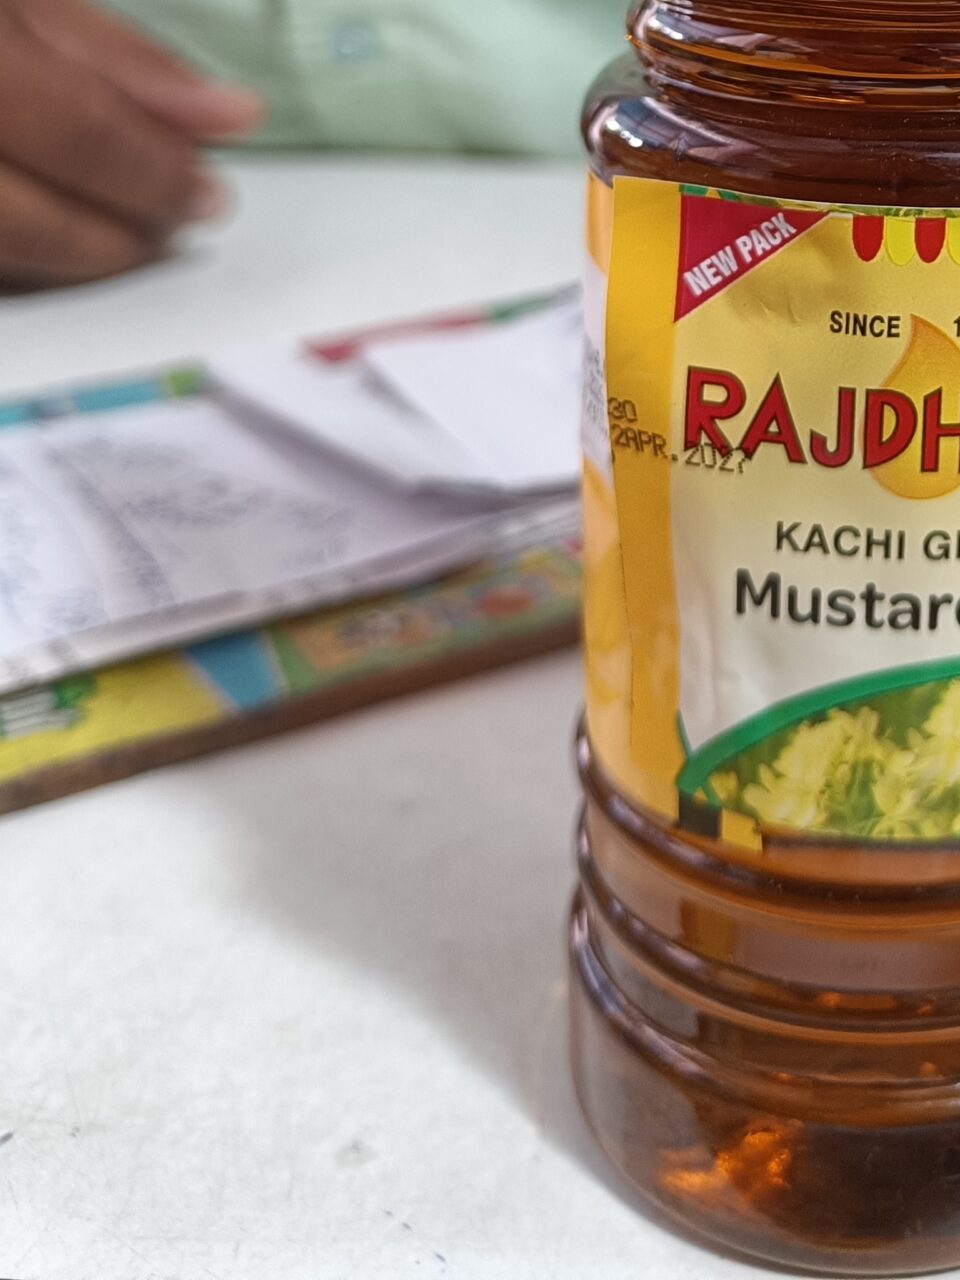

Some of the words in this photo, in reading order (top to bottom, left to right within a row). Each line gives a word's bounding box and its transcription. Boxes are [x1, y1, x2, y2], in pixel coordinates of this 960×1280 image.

[682, 245, 738, 297] NEW
[734, 211, 797, 263] PACK
[829, 310, 901, 338] SINCE
[775, 520, 905, 561] KACHI
